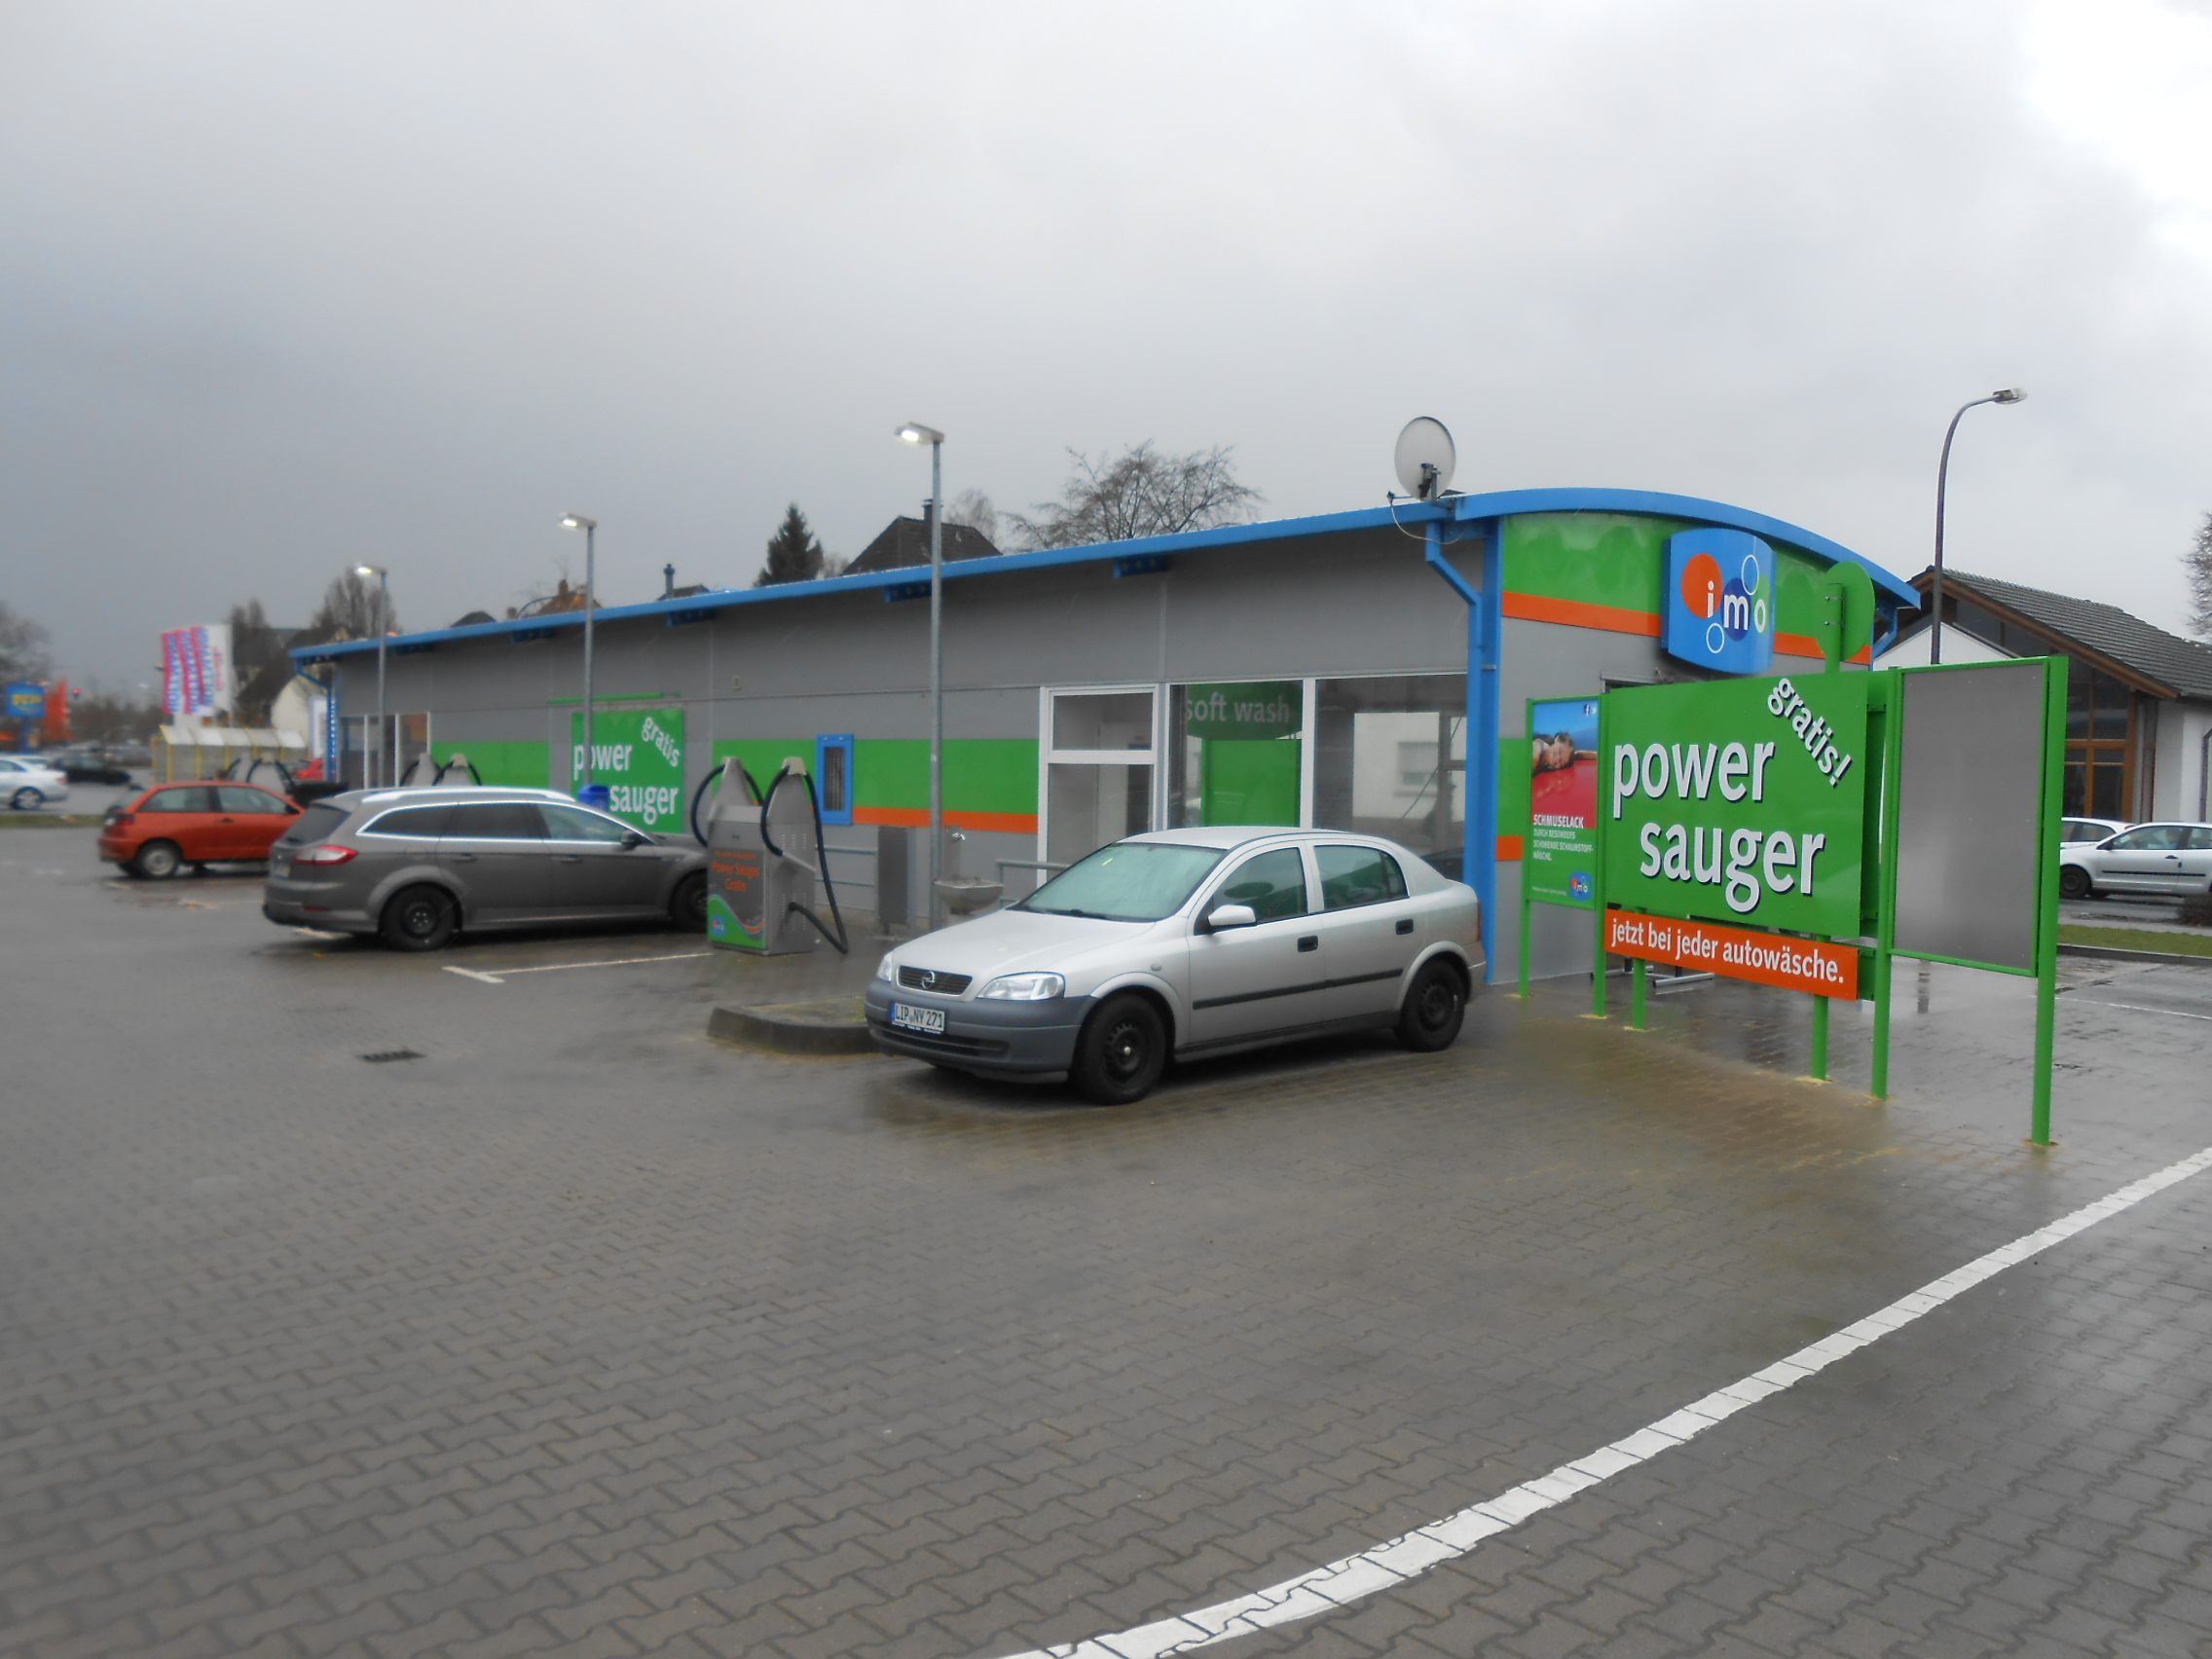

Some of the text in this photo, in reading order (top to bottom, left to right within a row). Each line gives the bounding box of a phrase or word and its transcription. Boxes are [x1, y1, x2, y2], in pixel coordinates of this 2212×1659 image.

[1708, 580, 1766, 633] imo
[1234, 695, 1291, 722] wash
[1767, 678, 1852, 788] gratis!
[642, 717, 681, 767] gratis
[609, 786, 679, 826] sauger
[1613, 742, 1775, 820] power
[1533, 814, 1584, 829] SCHMUSELACK
[1640, 823, 1826, 913] sauger
[1611, 918, 1844, 983] jetzt bei jeder autowäsche.
